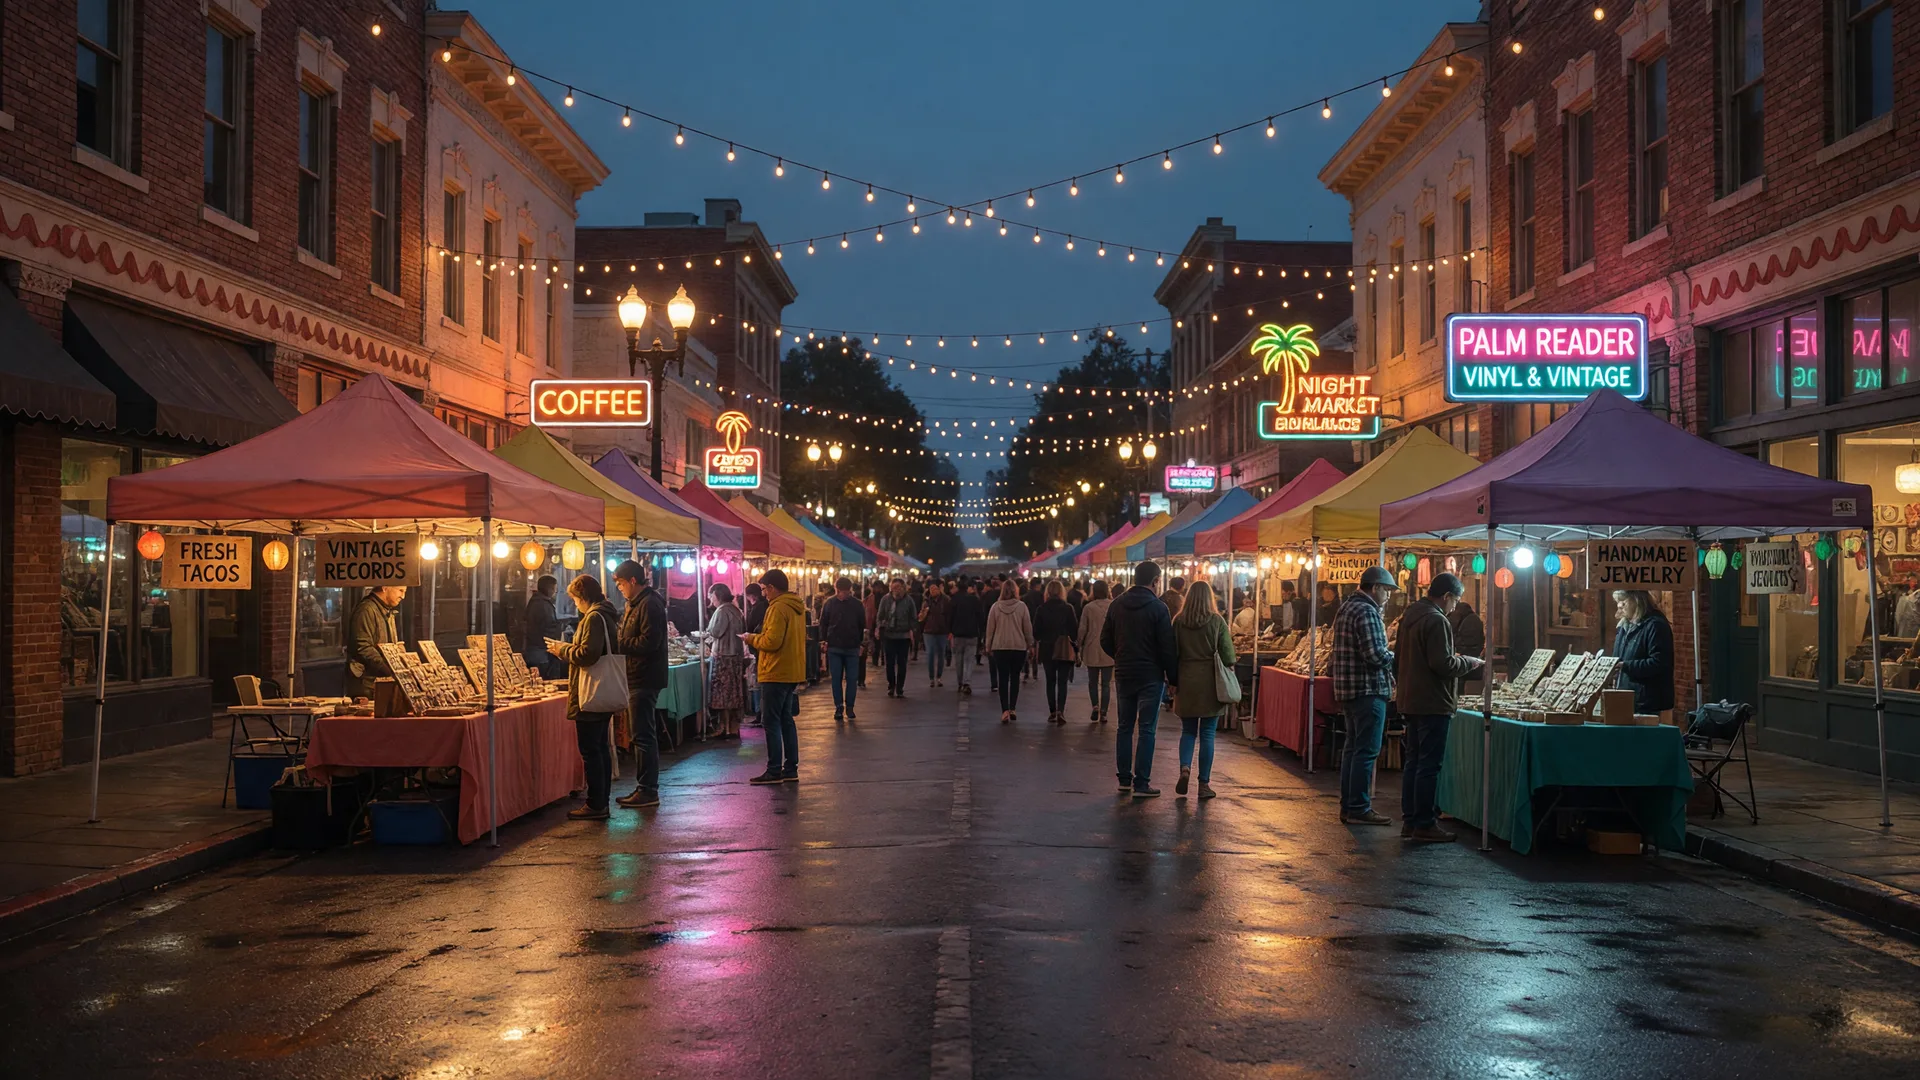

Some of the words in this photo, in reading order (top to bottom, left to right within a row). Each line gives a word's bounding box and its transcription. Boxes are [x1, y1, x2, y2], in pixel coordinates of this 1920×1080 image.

[1459, 327, 1526, 356] PALM
[1536, 327, 1635, 356] READER
[1298, 376, 1371, 395] NIGHT
[1463, 366, 1523, 387] VINYL
[1527, 366, 1541, 387] &
[1546, 366, 1632, 387] VINTAGE
[538, 389, 643, 415] COFFEE
[1302, 397, 1380, 414] MARKET
[180, 542, 237, 561] FRESH
[327, 540, 406, 559] VINTAGE
[1598, 545, 1687, 562] HANDMADE
[179, 563, 240, 582] TACOS
[325, 562, 406, 580] RECORDS
[1600, 566, 1685, 584] JEWELRY
